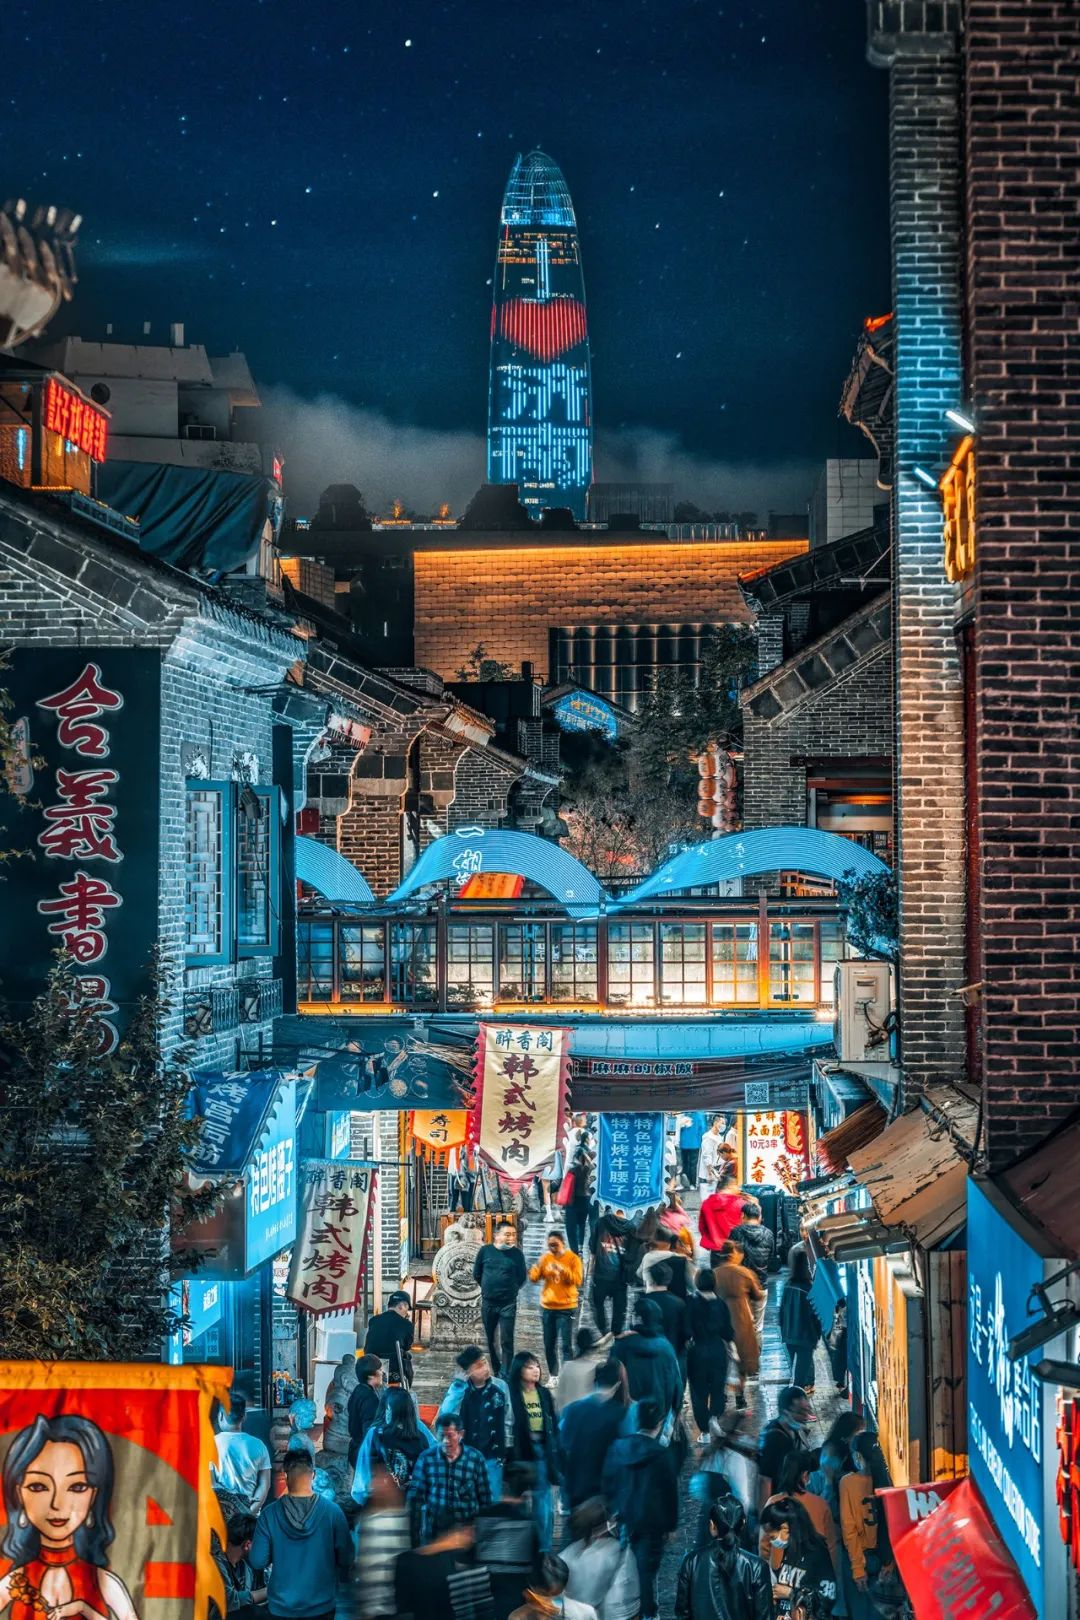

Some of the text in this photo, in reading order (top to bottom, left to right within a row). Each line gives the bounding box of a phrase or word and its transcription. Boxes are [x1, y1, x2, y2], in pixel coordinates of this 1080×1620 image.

[497, 1053, 540, 1167] 韩式烤肉
[748, 1124, 780, 1137] 大面筋
[609, 1118, 630, 1197] 特色烤牛腰子
[632, 1118, 654, 1198] 特色烤宫后筋
[302, 1193, 359, 1305] 韩式烤肉
